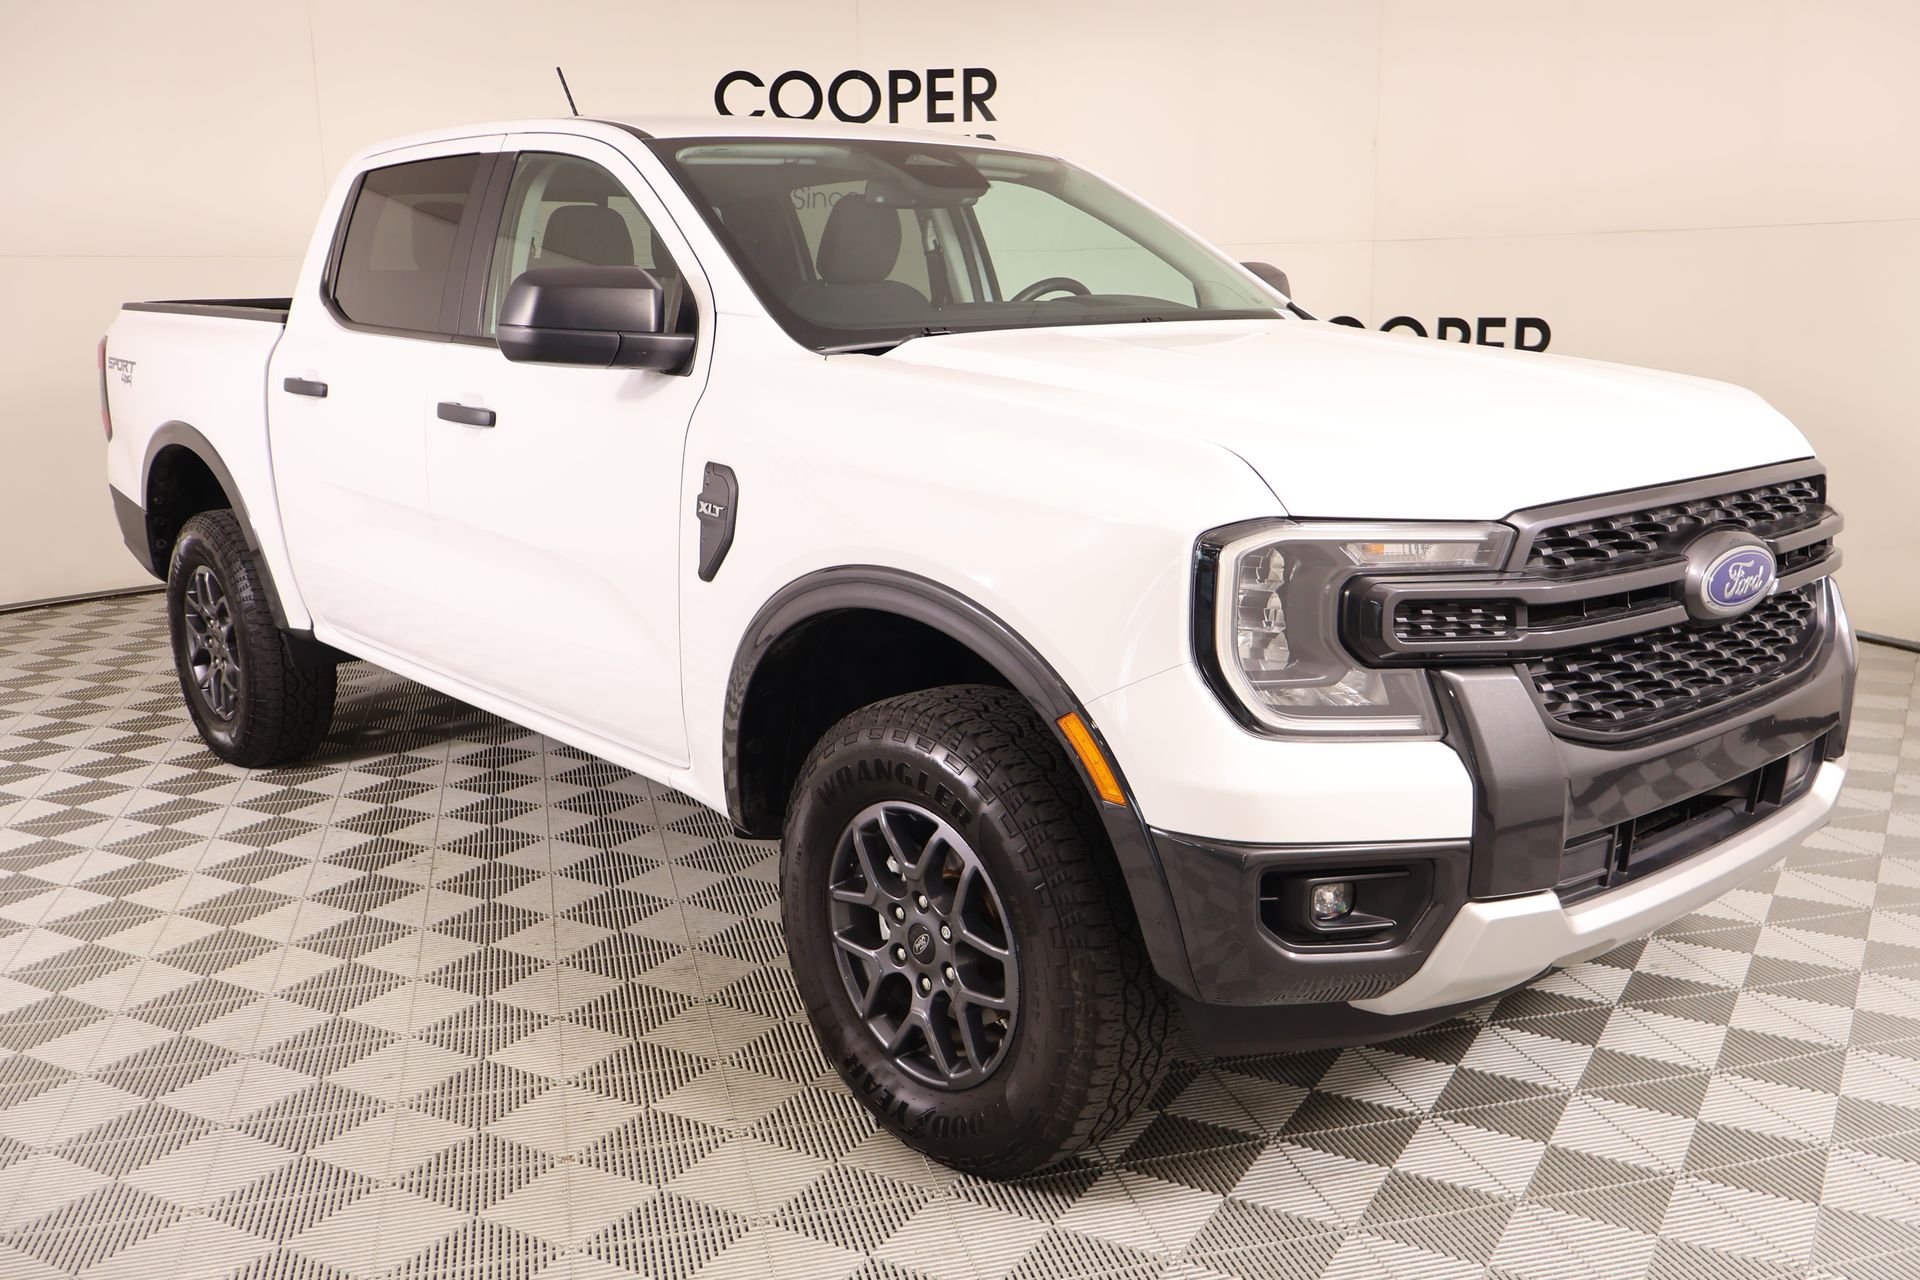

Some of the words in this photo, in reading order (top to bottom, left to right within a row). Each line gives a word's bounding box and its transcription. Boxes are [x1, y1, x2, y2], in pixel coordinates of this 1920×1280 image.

[714, 68, 998, 123] COOPER
[793, 188, 858, 210] Sinc
[108, 357, 136, 374] SPORT
[699, 501, 725, 518] XLT
[1724, 559, 1764, 598] Ford
[816, 758, 973, 829] WRANGLER
